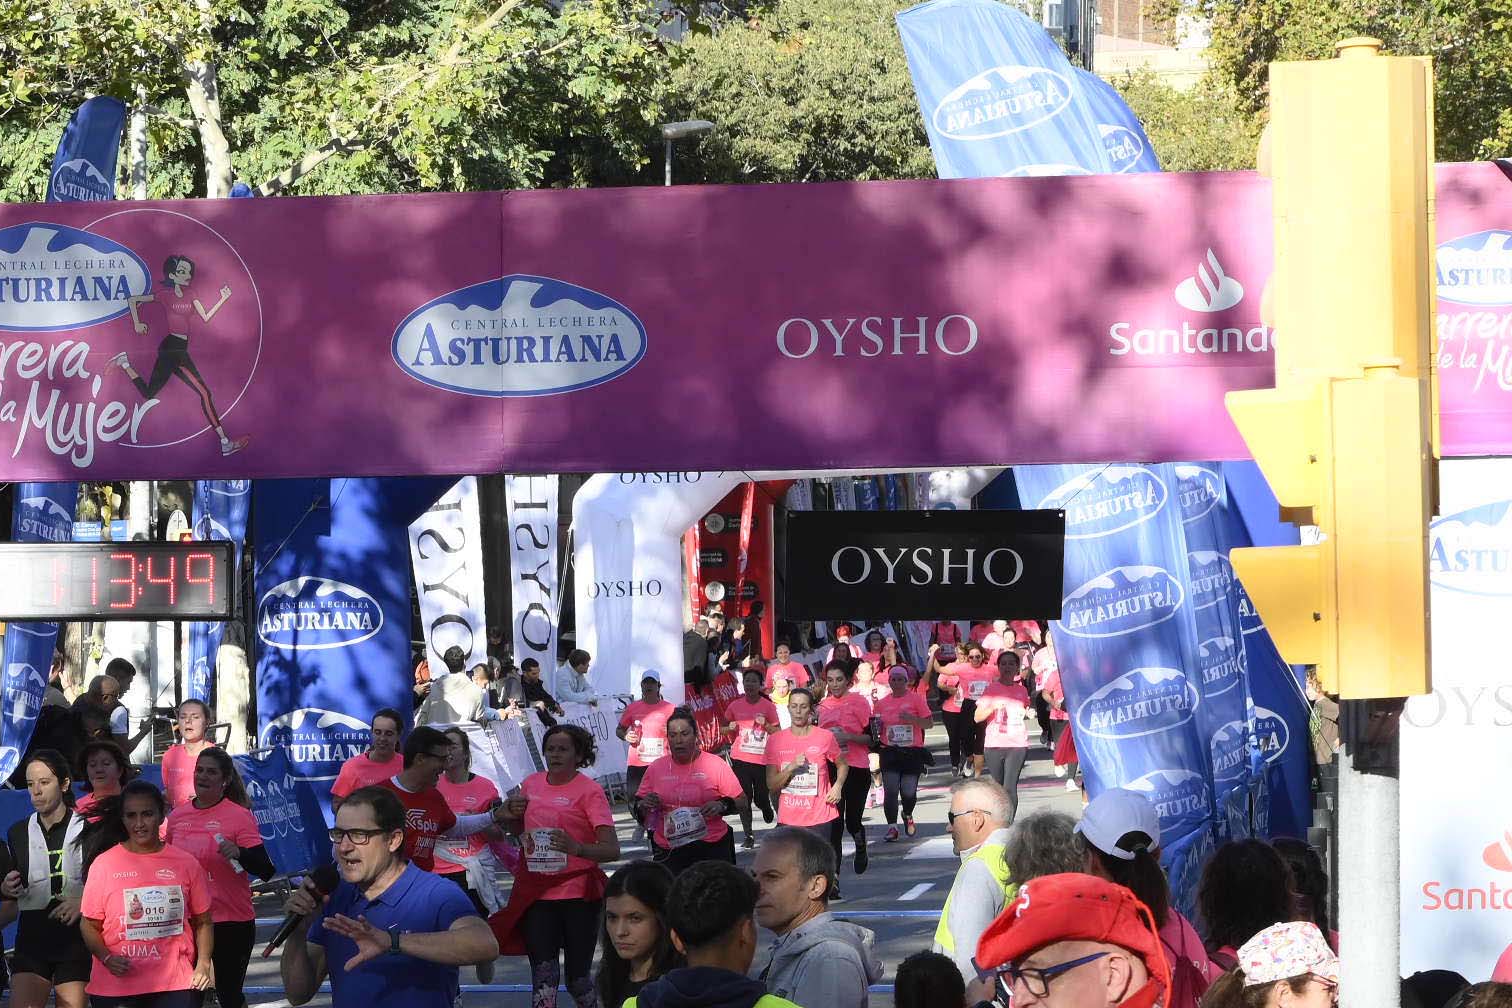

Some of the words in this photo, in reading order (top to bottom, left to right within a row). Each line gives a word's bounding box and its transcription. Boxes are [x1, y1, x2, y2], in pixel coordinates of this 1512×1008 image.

[54, 259, 126, 270] LECHERA
[451, 319, 528, 330] CENTRAL
[538, 316, 618, 327] LECHERA
[412, 322, 626, 366] ASTURIANA
[776, 315, 979, 360] OYSHO
[11, 375, 160, 467] Mujer
[831, 546, 1024, 588] OYSHO
[587, 579, 663, 600] OYSHO
[274, 601, 316, 609] CENTRAL
[320, 600, 369, 608] LECHERA
[261, 606, 374, 634] ASTURIANA
[784, 796, 810, 807] SUMA
[145, 906, 165, 916] 016
[120, 944, 159, 958] SUMA
